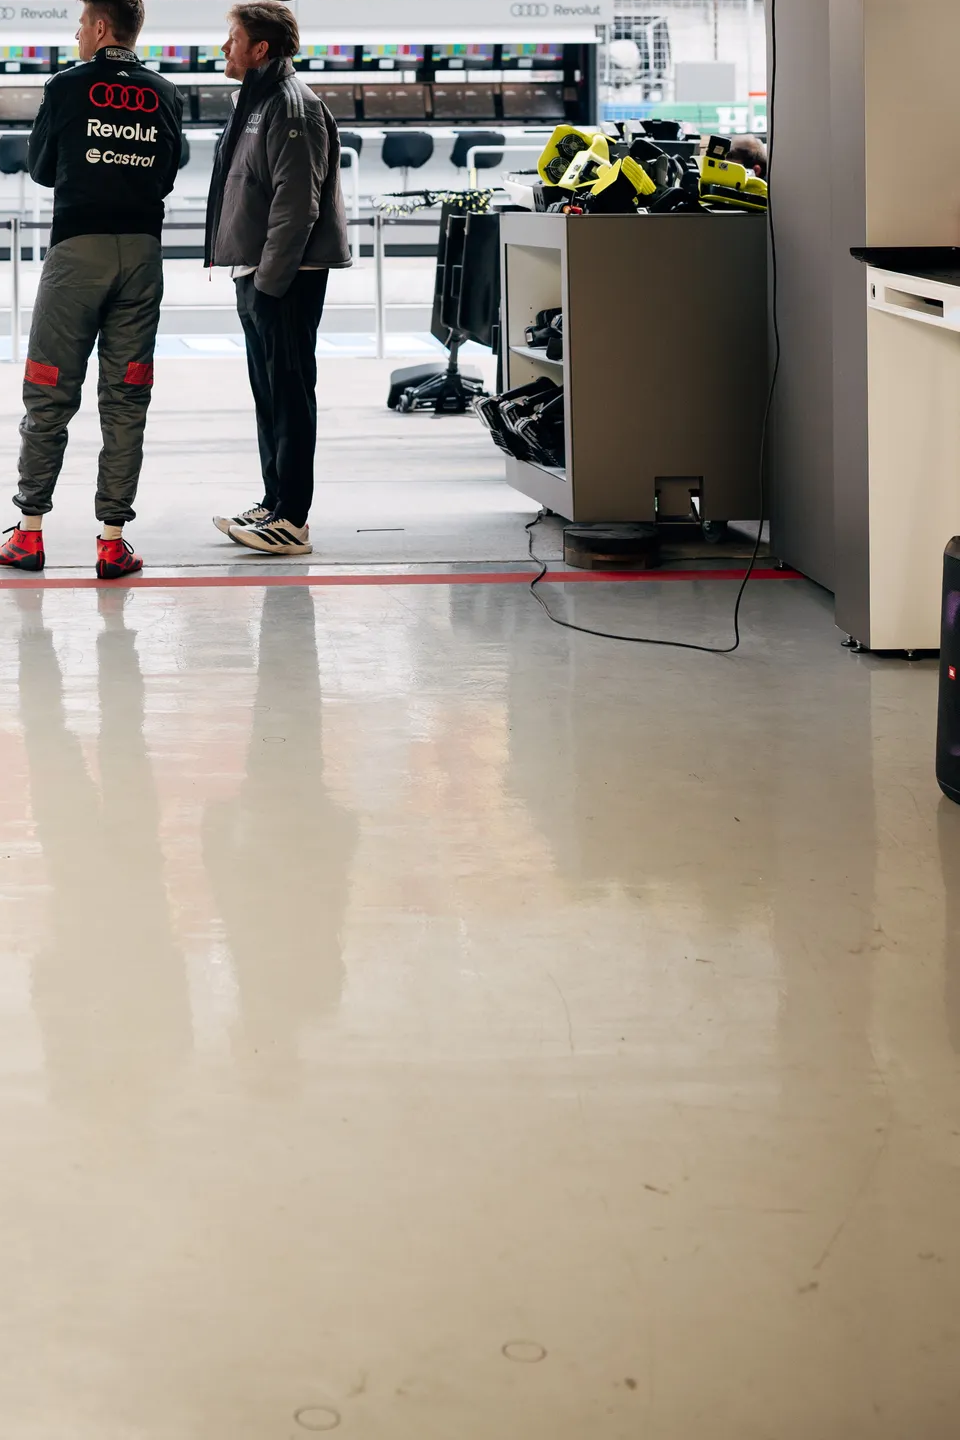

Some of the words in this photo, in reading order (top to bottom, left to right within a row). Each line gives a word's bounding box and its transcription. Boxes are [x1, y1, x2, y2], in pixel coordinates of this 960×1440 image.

[20, 7, 69, 19] Revolut
[553, 4, 600, 16] Revolut
[86, 118, 158, 143] Revolut
[102, 150, 156, 168] Castrol
